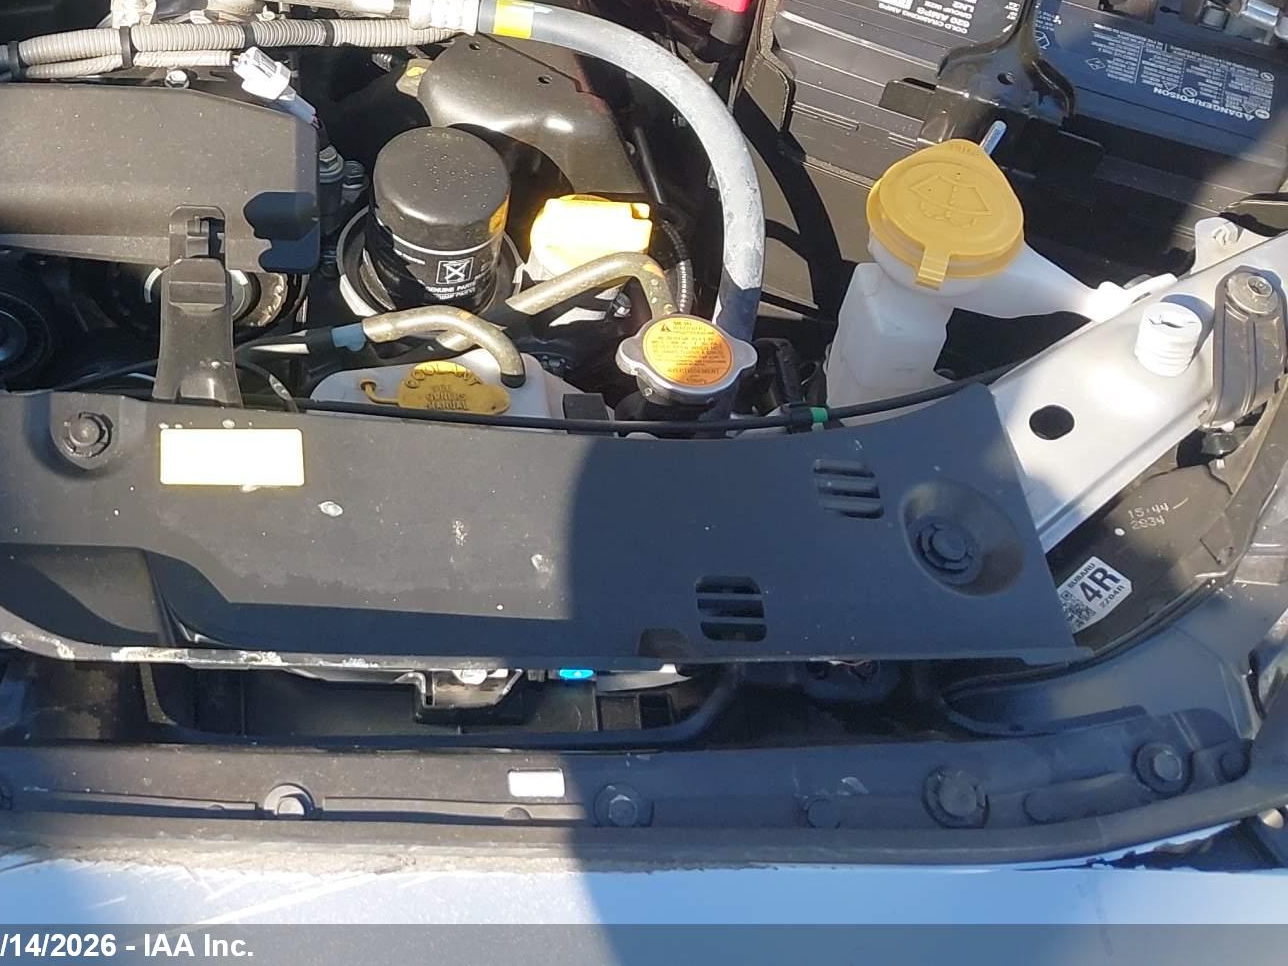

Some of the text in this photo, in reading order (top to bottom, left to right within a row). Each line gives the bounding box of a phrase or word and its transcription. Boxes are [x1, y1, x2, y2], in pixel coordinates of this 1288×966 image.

[878, 2, 968, 34] COLD CRANKING AMPS
[916, 6, 949, 21] AMPS
[1153, 86, 1246, 119] DANGER/POISON
[1067, 562, 1096, 588] SUBARU
[1079, 567, 1121, 602] 4R
